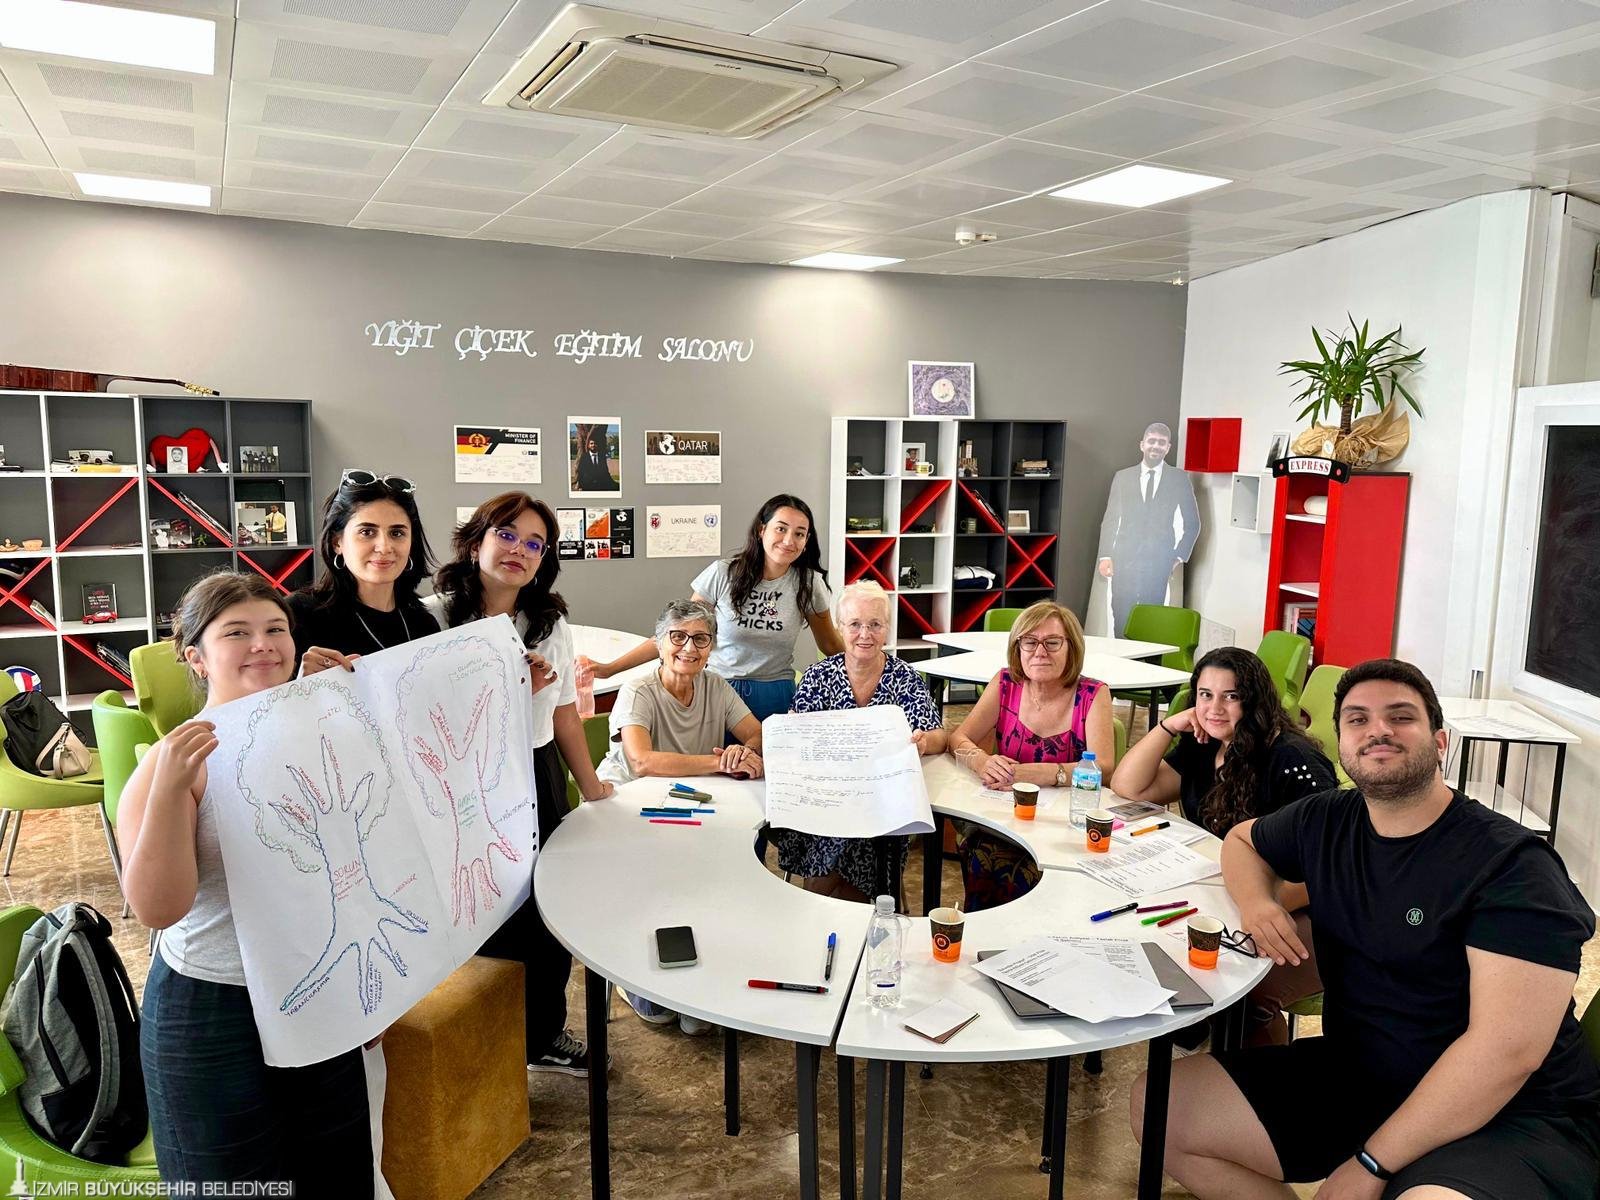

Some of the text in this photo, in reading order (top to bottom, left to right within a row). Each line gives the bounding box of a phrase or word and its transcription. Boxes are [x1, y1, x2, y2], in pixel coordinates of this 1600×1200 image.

[454, 325, 538, 361] ÇİÇEK
[554, 329, 643, 364] EĞİTİM
[658, 337, 754, 362] SALONU
[678, 440, 708, 451] QATAR
[1290, 460, 1330, 472] EXPRESS
[737, 617, 784, 632] HICKS
